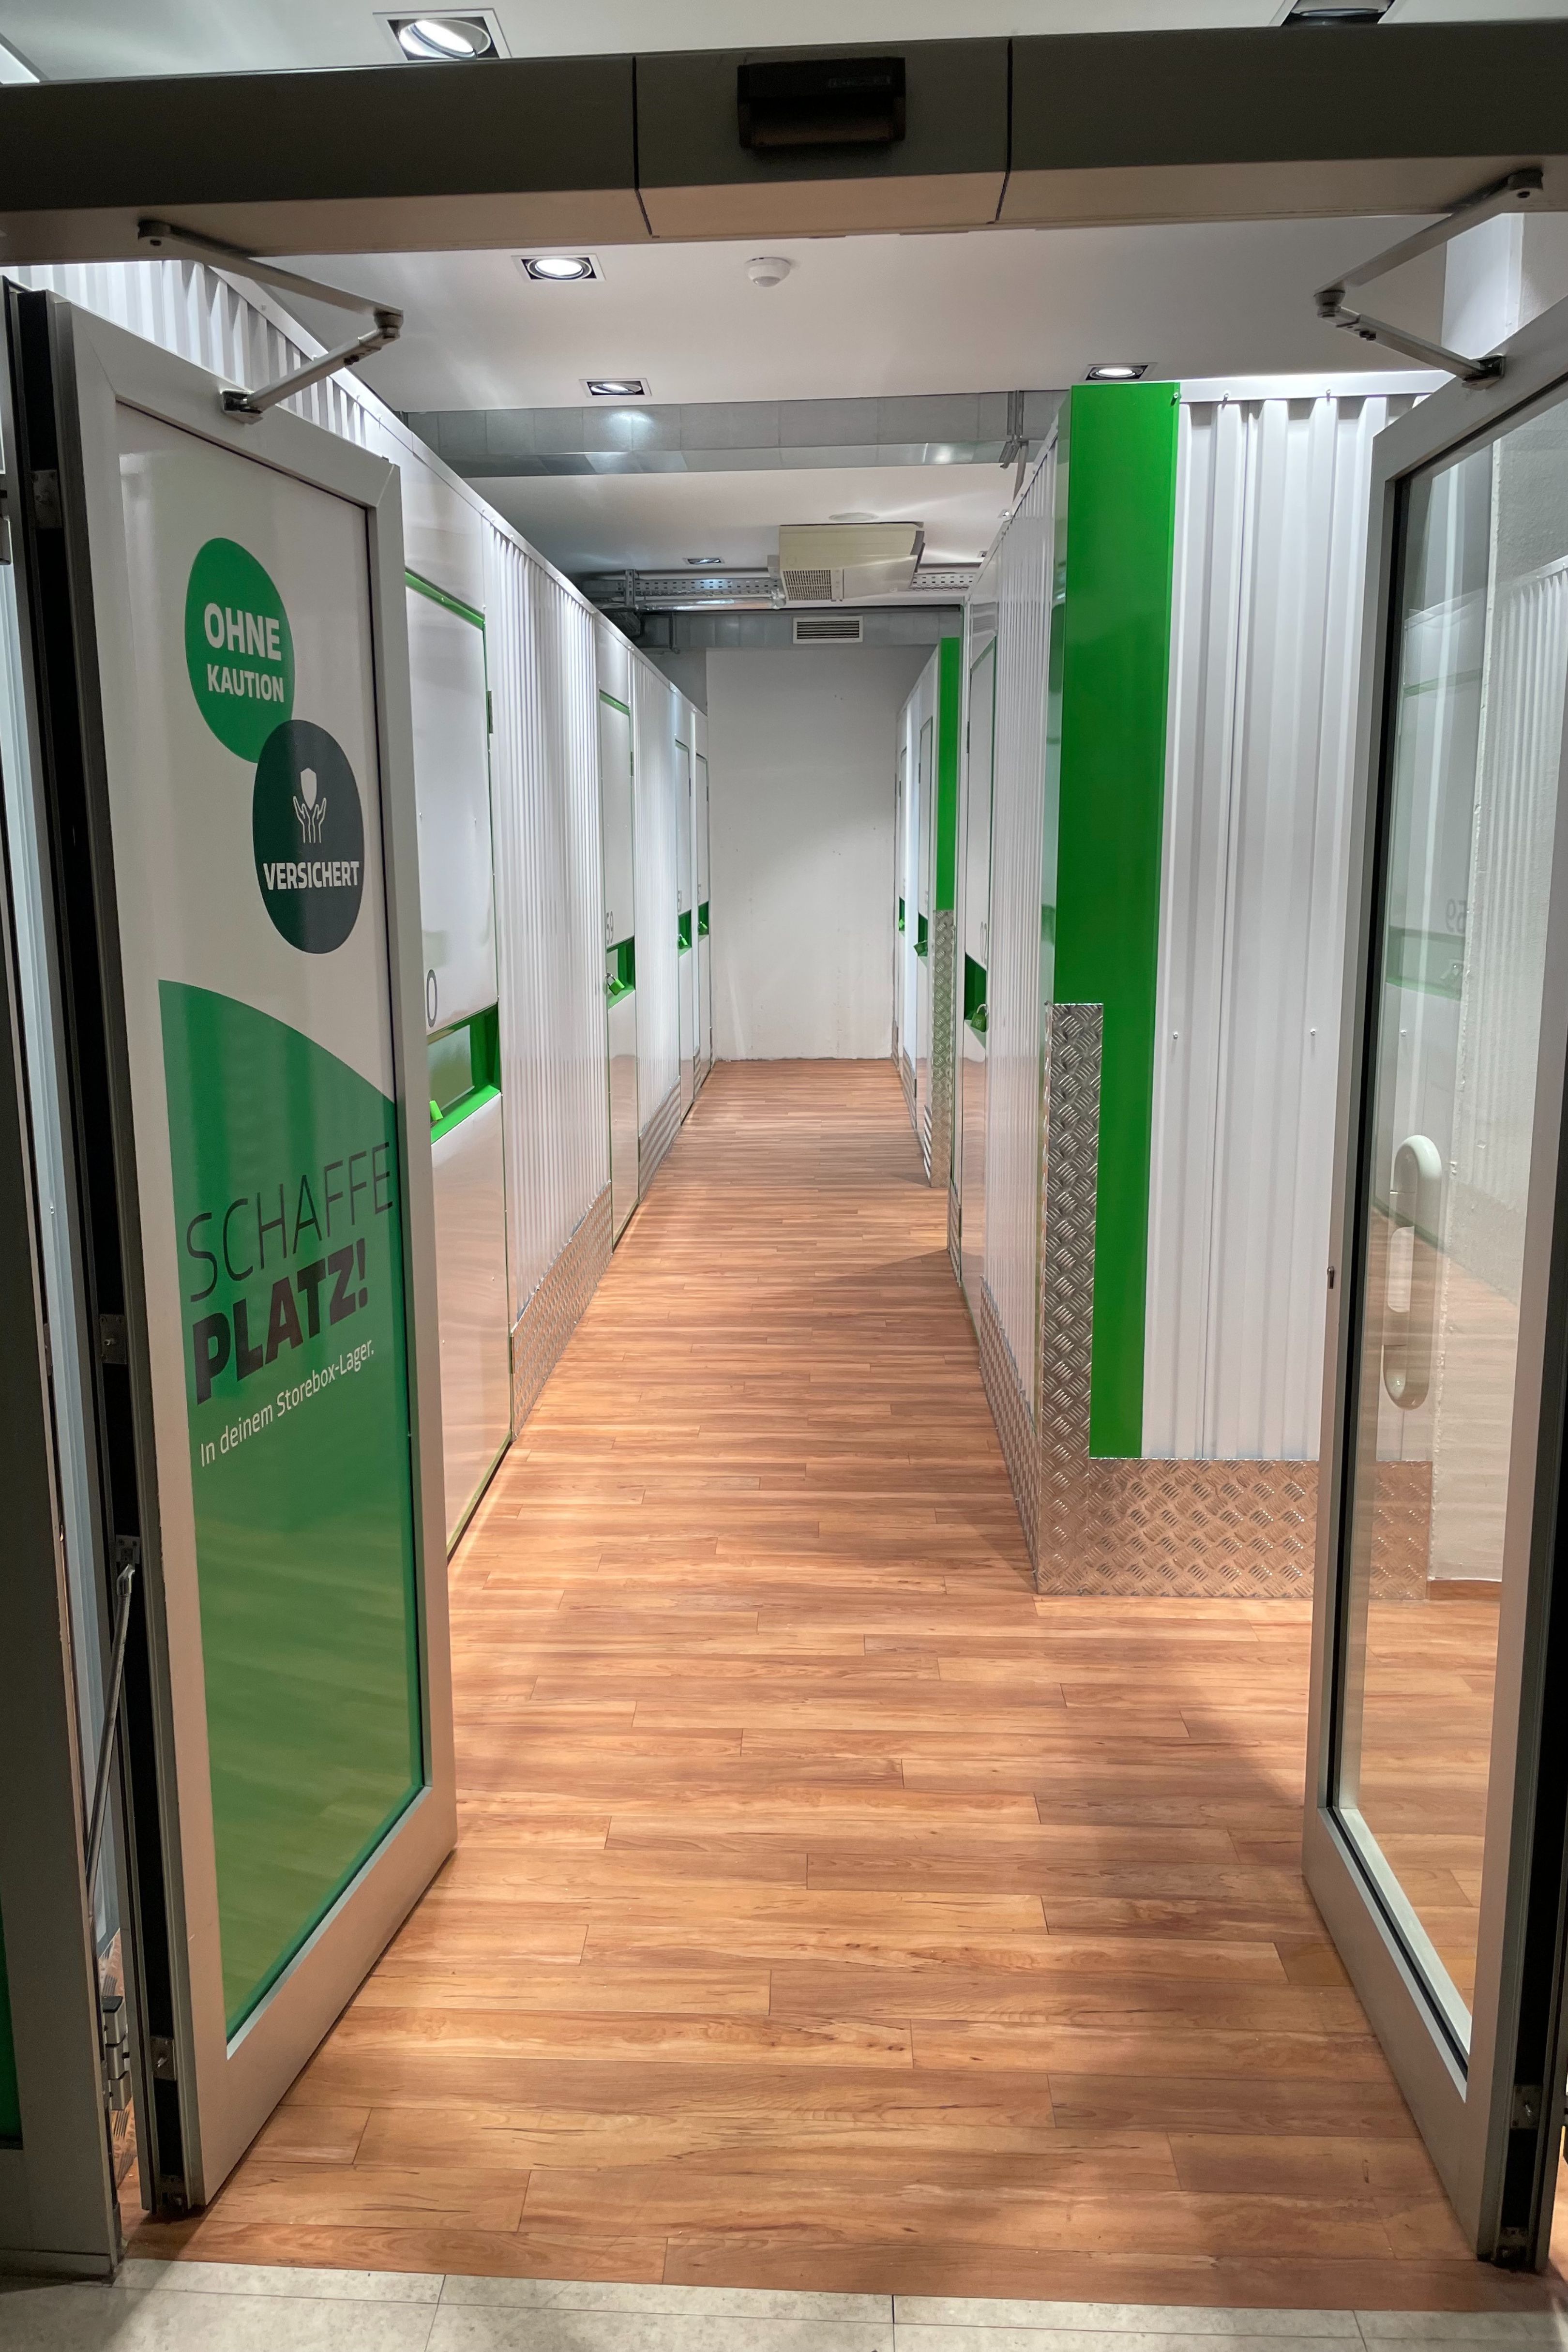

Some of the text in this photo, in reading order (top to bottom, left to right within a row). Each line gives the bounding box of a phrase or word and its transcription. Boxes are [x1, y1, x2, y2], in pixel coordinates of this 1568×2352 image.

[204, 603, 282, 662] OHNE
[207, 663, 284, 703] KAUTION
[263, 860, 360, 890] VERSICHERT
[606, 911, 614, 946] 59
[186, 1142, 393, 1302] SCHAFFE
[193, 1237, 368, 1405] PLATZ!
[200, 1340, 375, 1467] In deinem Storebox-Lager.
